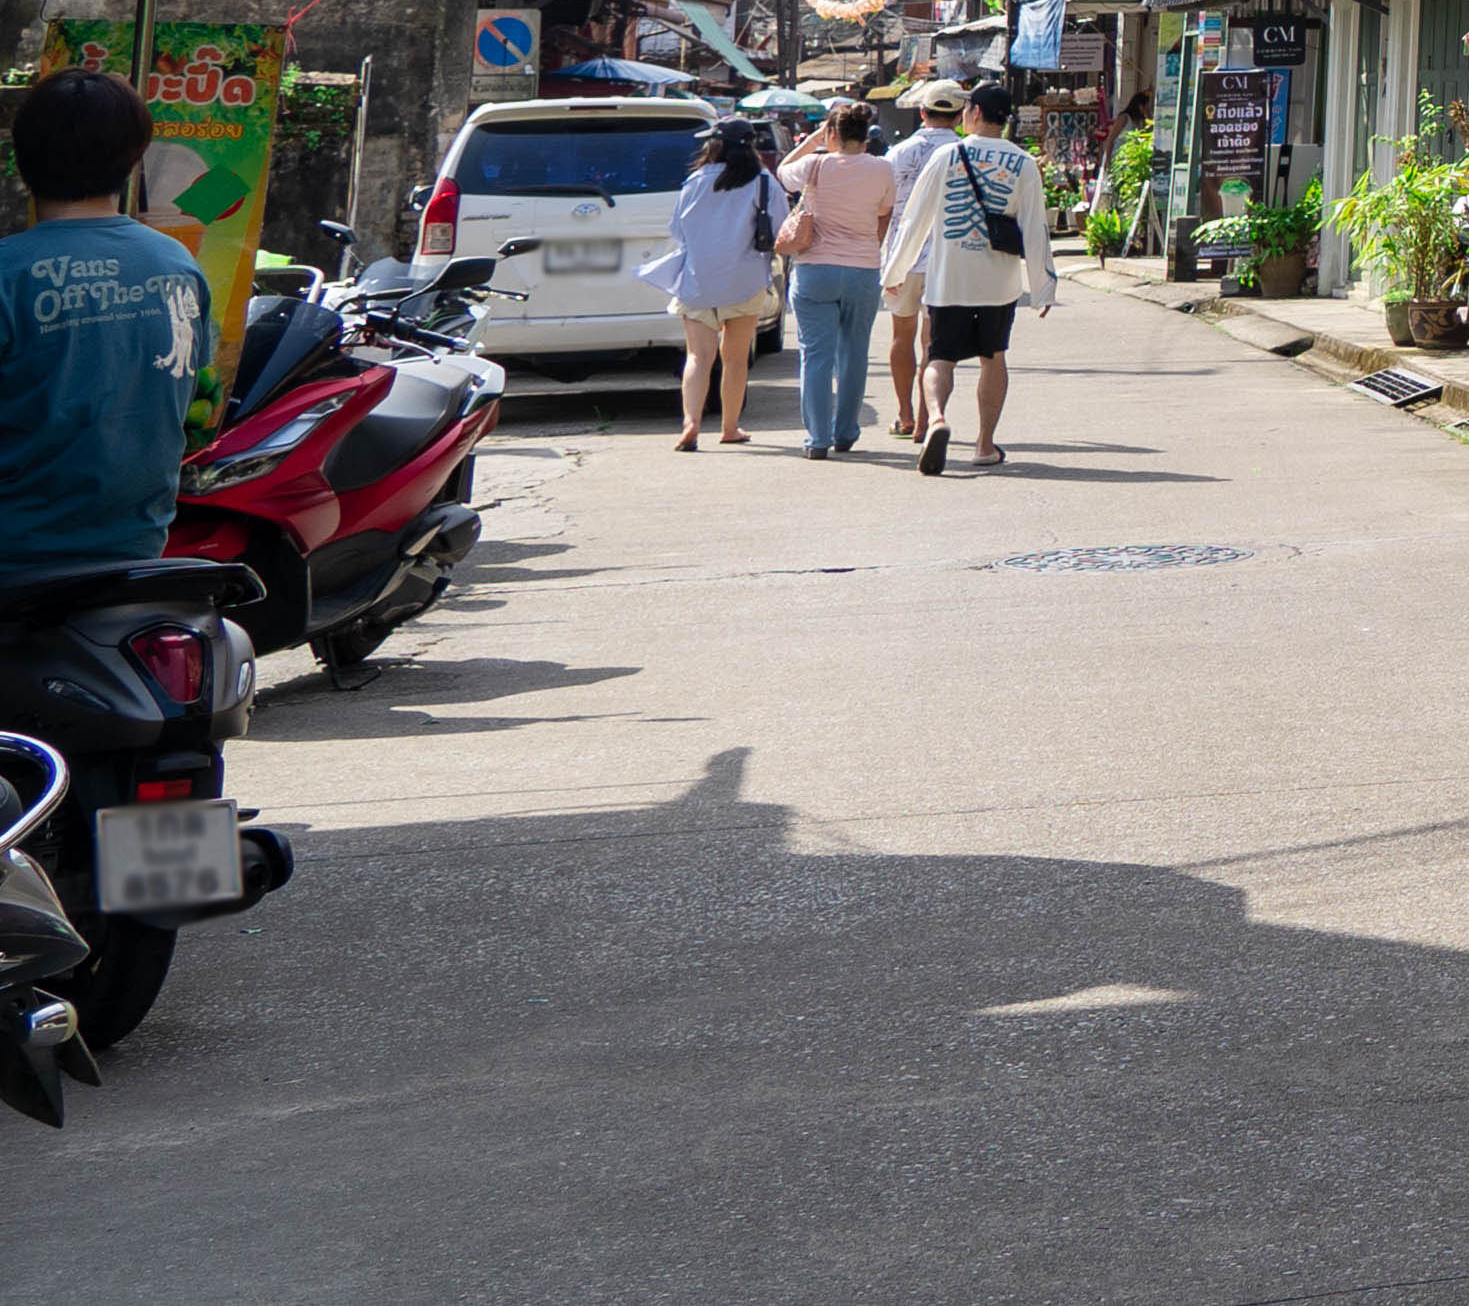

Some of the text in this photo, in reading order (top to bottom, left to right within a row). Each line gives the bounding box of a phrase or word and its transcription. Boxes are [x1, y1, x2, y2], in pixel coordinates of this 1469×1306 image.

[1263, 26, 1295, 43] CM
[1222, 75, 1249, 89] CM
[999, 151, 1030, 177] TEA
[31, 255, 120, 287] Vans
[34, 282, 89, 323] Off
[89, 279, 145, 311] The
